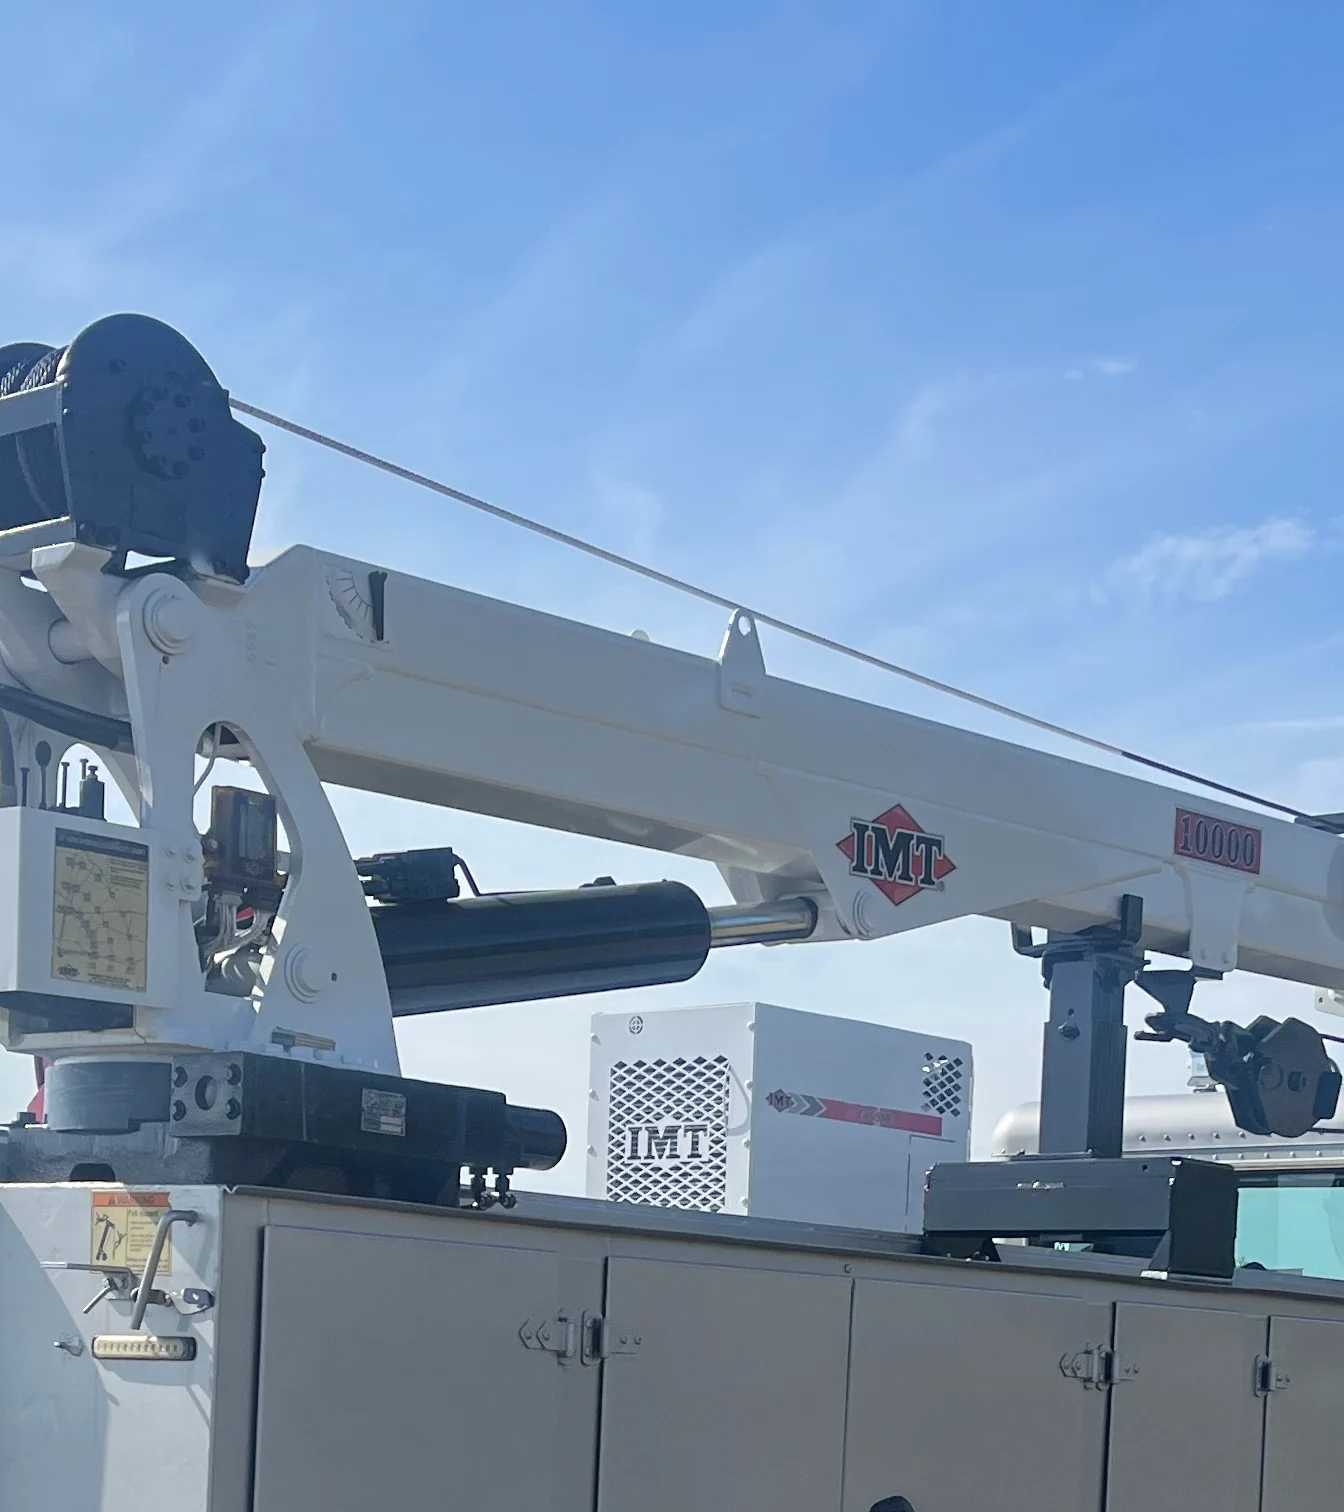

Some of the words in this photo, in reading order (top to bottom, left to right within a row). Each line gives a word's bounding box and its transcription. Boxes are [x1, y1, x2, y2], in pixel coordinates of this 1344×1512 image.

[850, 818, 944, 889] IMT
[1178, 814, 1256, 869] 10000
[767, 1091, 793, 1109] IMT
[626, 1123, 708, 1161] IMT
